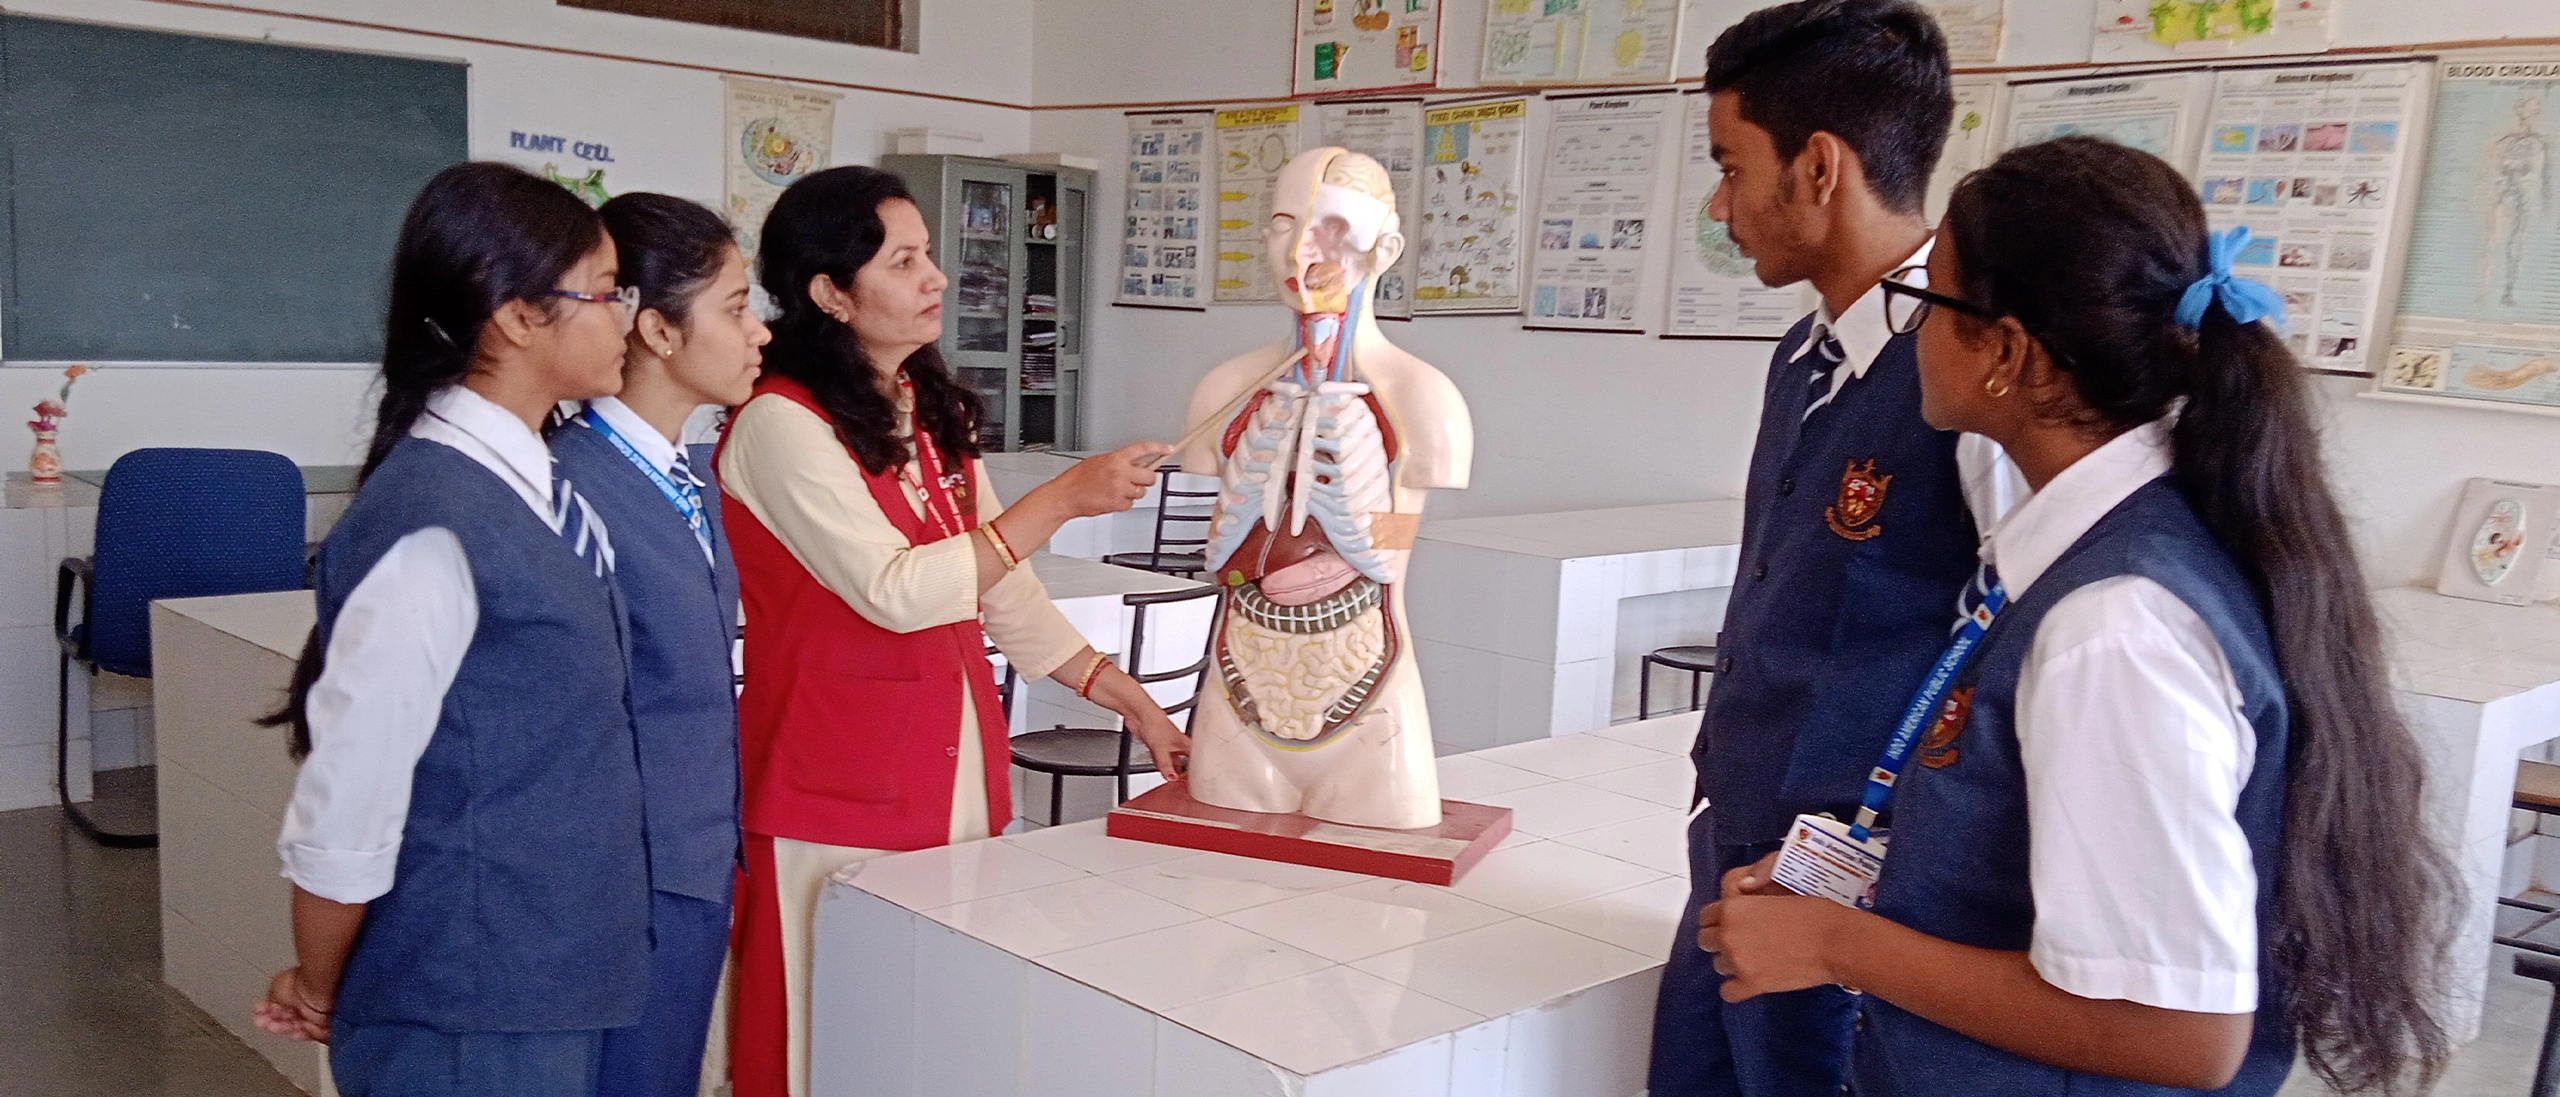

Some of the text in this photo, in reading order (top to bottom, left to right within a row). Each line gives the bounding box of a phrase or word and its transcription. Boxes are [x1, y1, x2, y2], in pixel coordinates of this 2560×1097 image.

[2448, 66, 2494, 77] BLOOD
[510, 131, 615, 162] PLANT CELL
